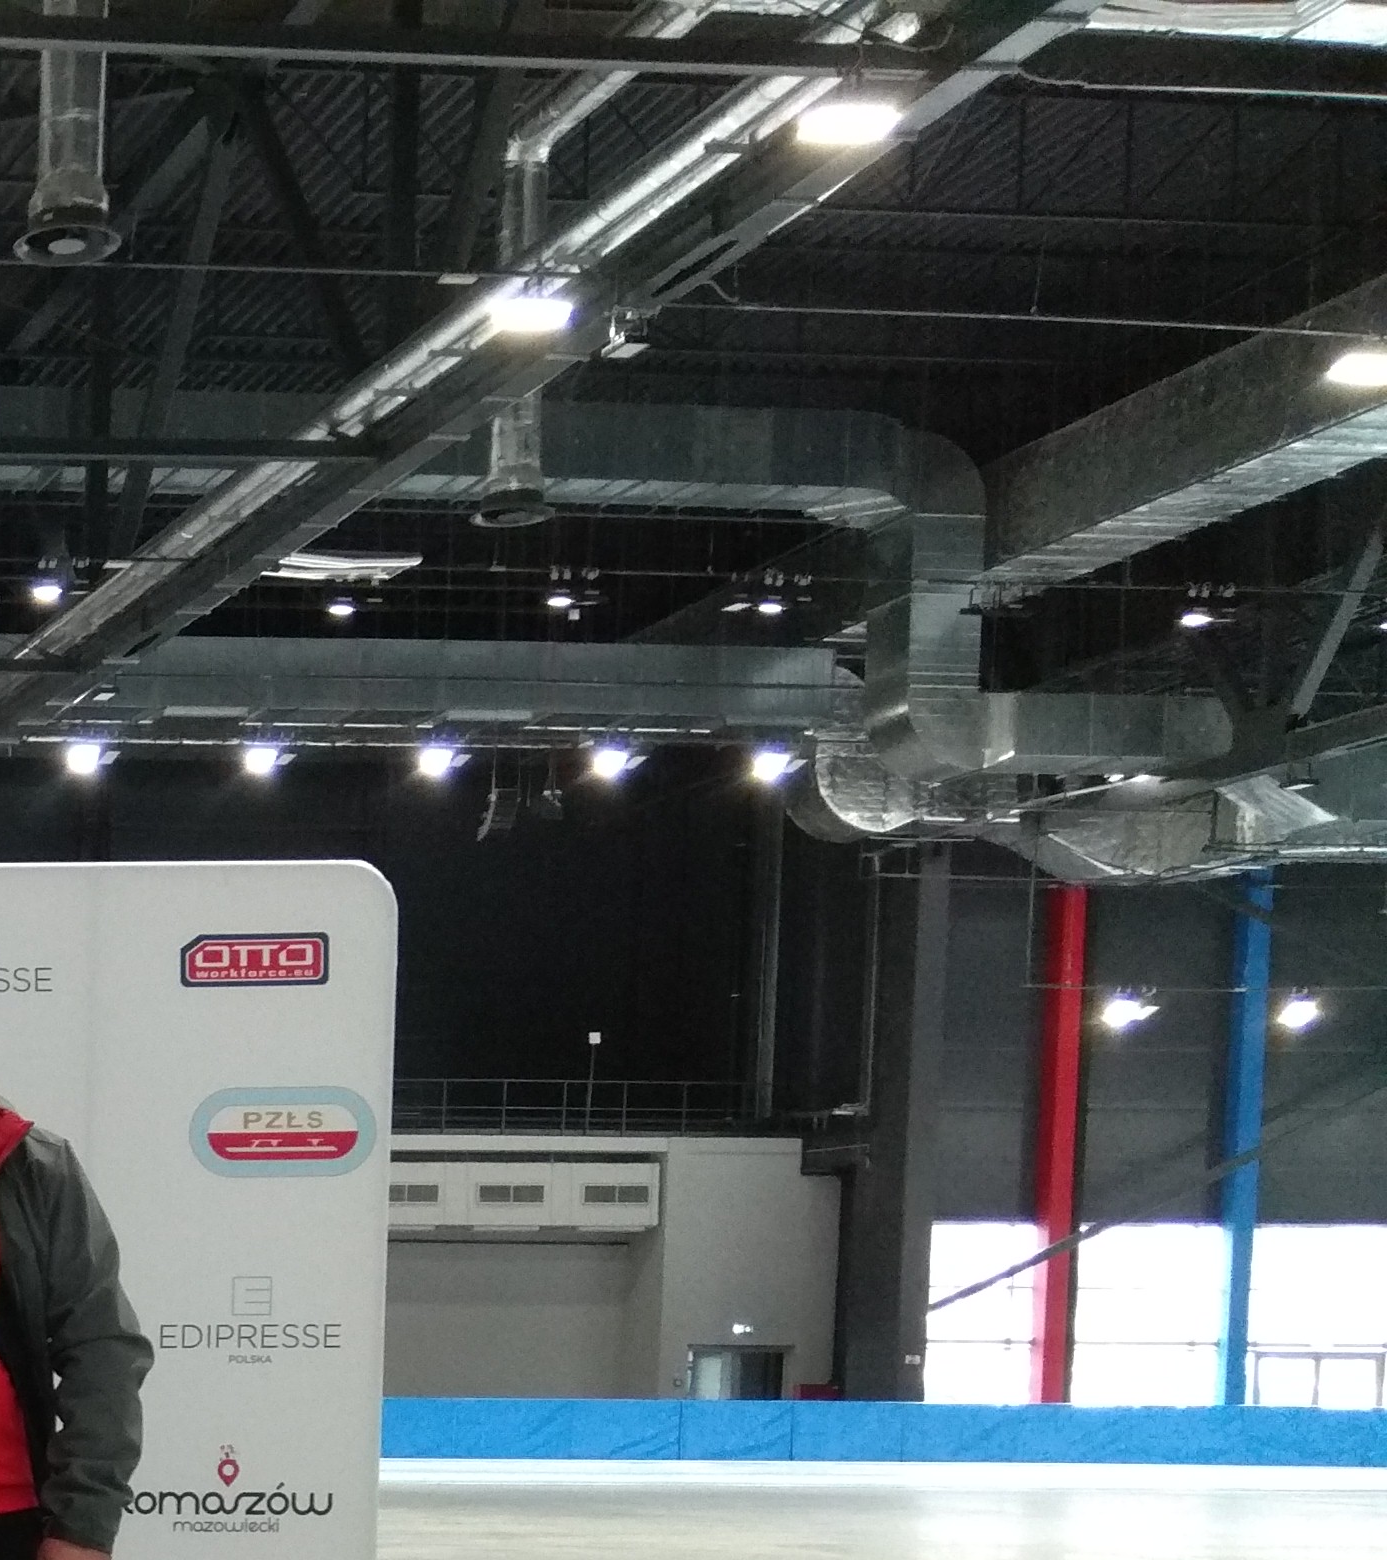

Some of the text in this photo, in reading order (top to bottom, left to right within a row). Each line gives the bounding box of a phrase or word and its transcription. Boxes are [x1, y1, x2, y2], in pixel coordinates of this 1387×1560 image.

[194, 943, 314, 968] OTTO
[194, 967, 314, 979] workforce.eu
[243, 1111, 324, 1129] PZŁS
[159, 1324, 342, 1349] EDIPRESSE
[228, 1355, 273, 1364] POLSKA
[125, 1482, 333, 1515] omaszów
[172, 1517, 280, 1533] mazowiecki
